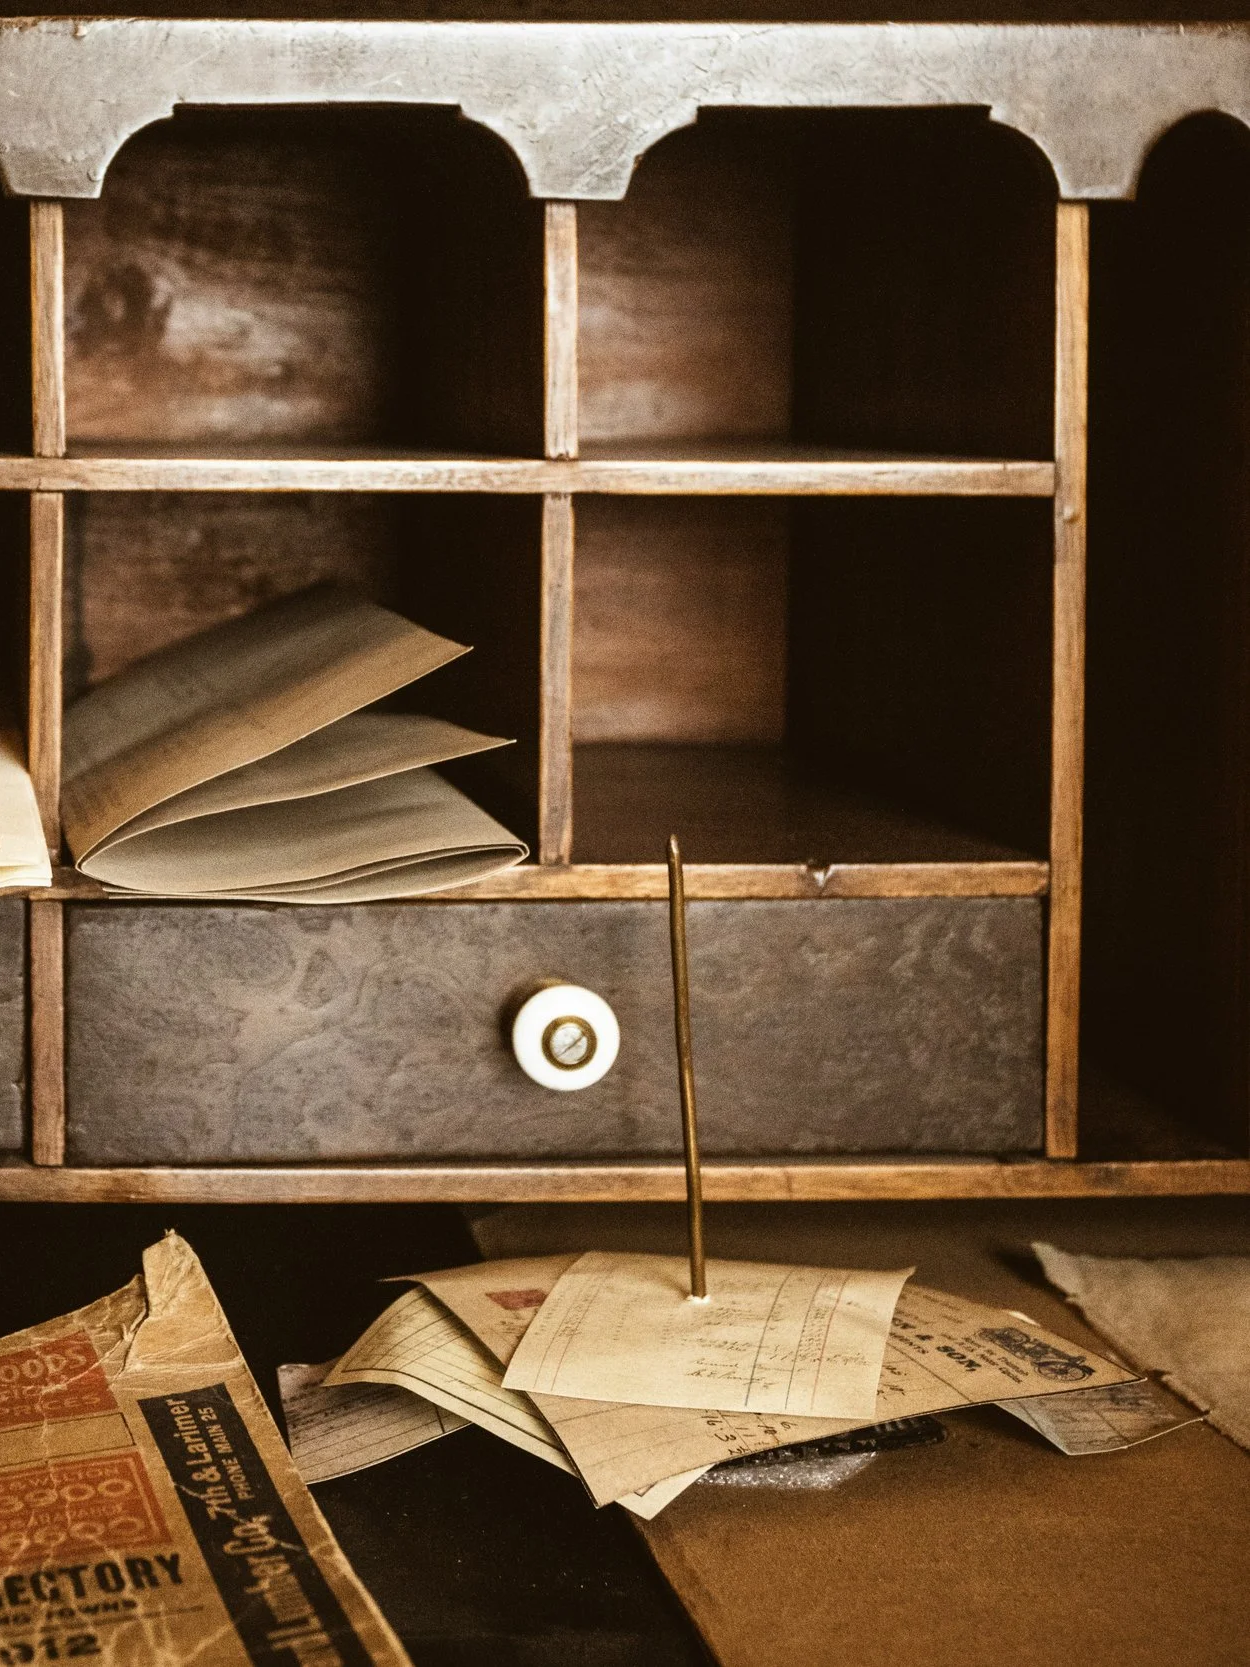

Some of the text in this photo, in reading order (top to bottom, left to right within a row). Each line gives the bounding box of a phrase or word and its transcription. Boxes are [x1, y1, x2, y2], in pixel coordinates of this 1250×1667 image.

[167, 1397, 238, 1521] 7th & Larimer
[197, 1406, 255, 1501] PHONE MAIN 25
[46, 1599, 137, 1622] TOWNS
